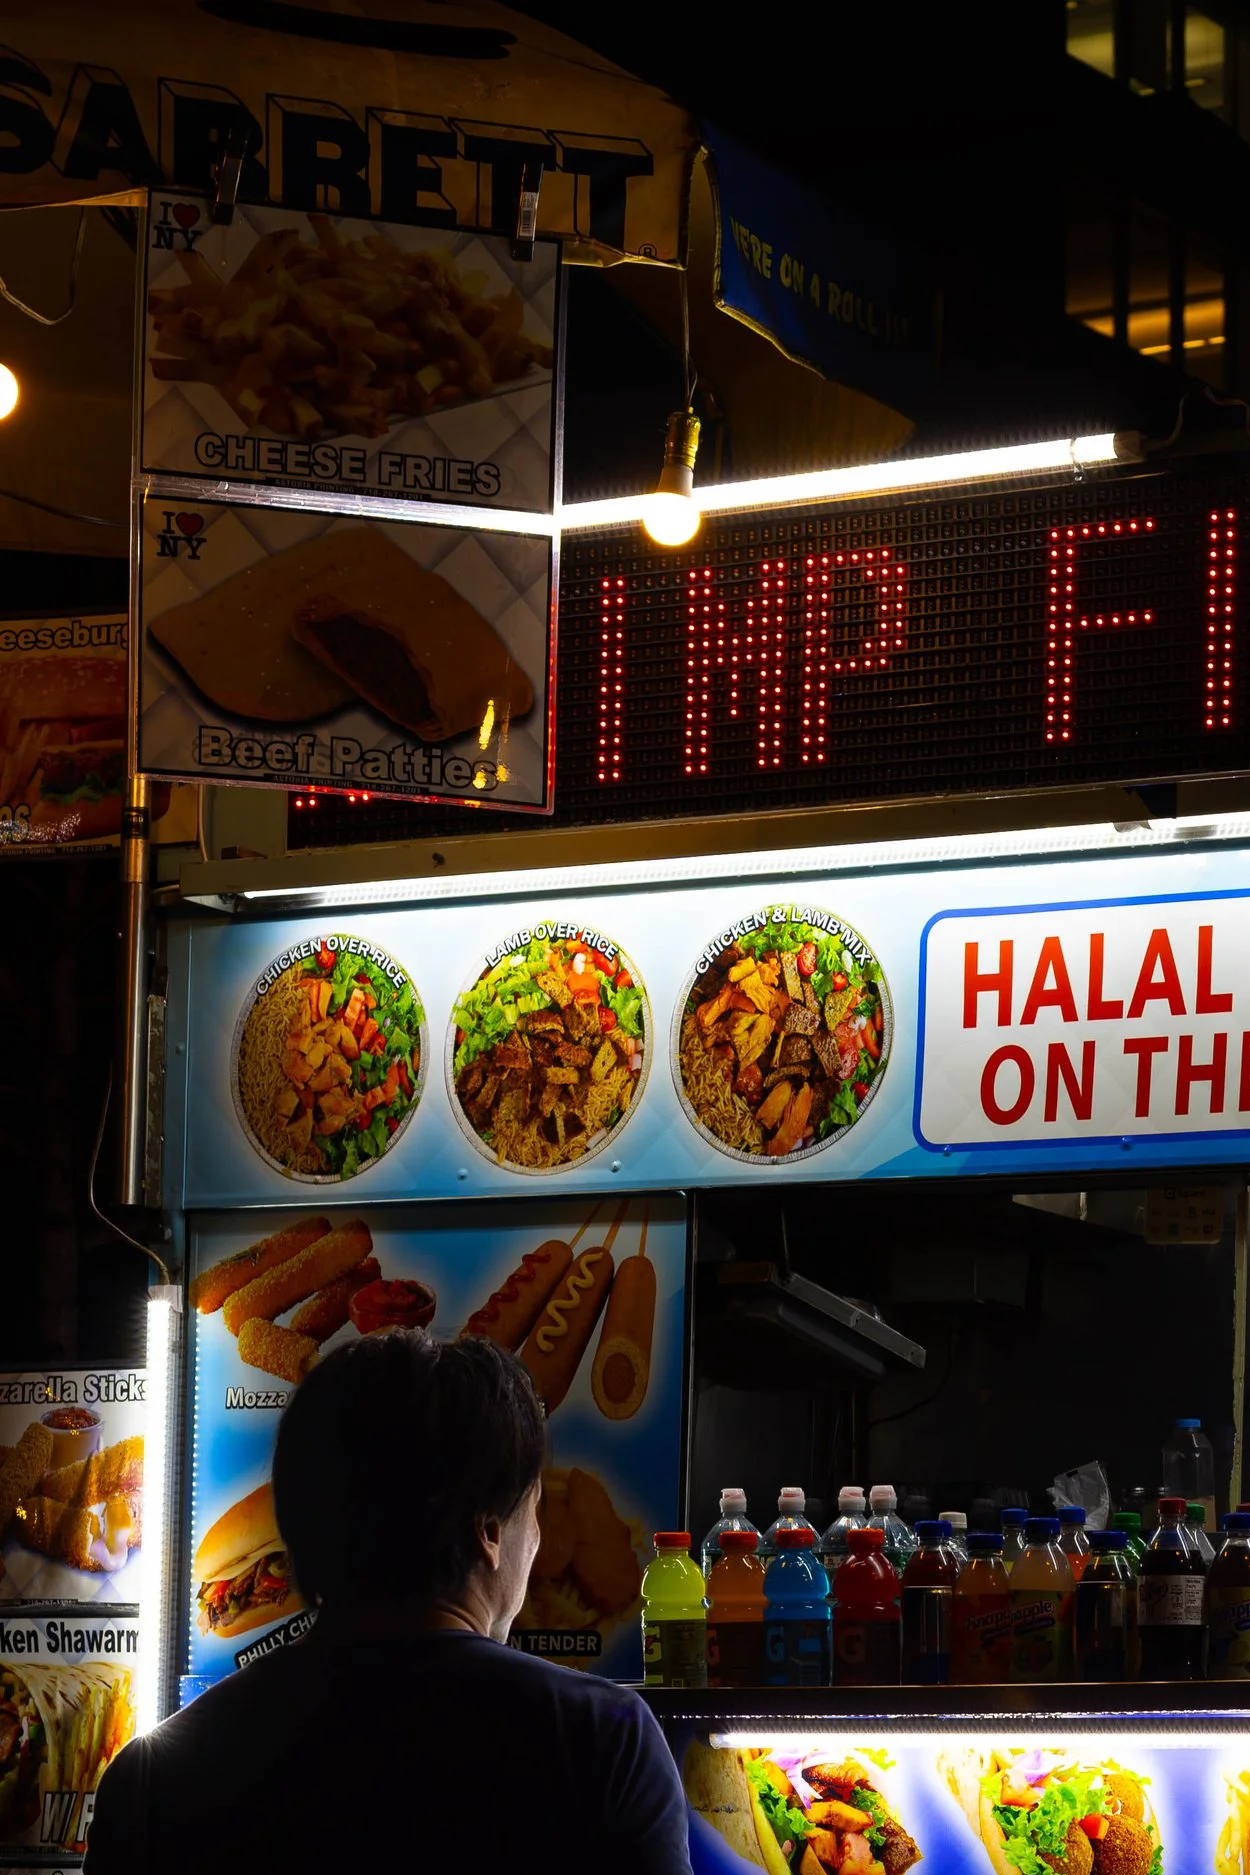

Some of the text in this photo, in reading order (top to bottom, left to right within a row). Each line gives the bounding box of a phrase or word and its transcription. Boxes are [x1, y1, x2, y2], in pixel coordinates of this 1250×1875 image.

[152, 225, 205, 253] NY
[779, 253, 879, 336] ON A ROLL
[194, 432, 501, 497] CHEESE FRIES
[155, 535, 207, 561] NY
[197, 727, 500, 792] Beef Patties
[256, 935, 407, 996] CHICKEN OVER RICE
[485, 922, 619, 968] LAMB OVER RICE
[695, 906, 873, 974] CHICKEN & LAMB MIX
[963, 925, 1234, 1029] HALAL
[979, 1040, 1096, 1126] ON
[238, 1629, 286, 1669] PHILLY
[528, 1635, 598, 1652] TENDER
